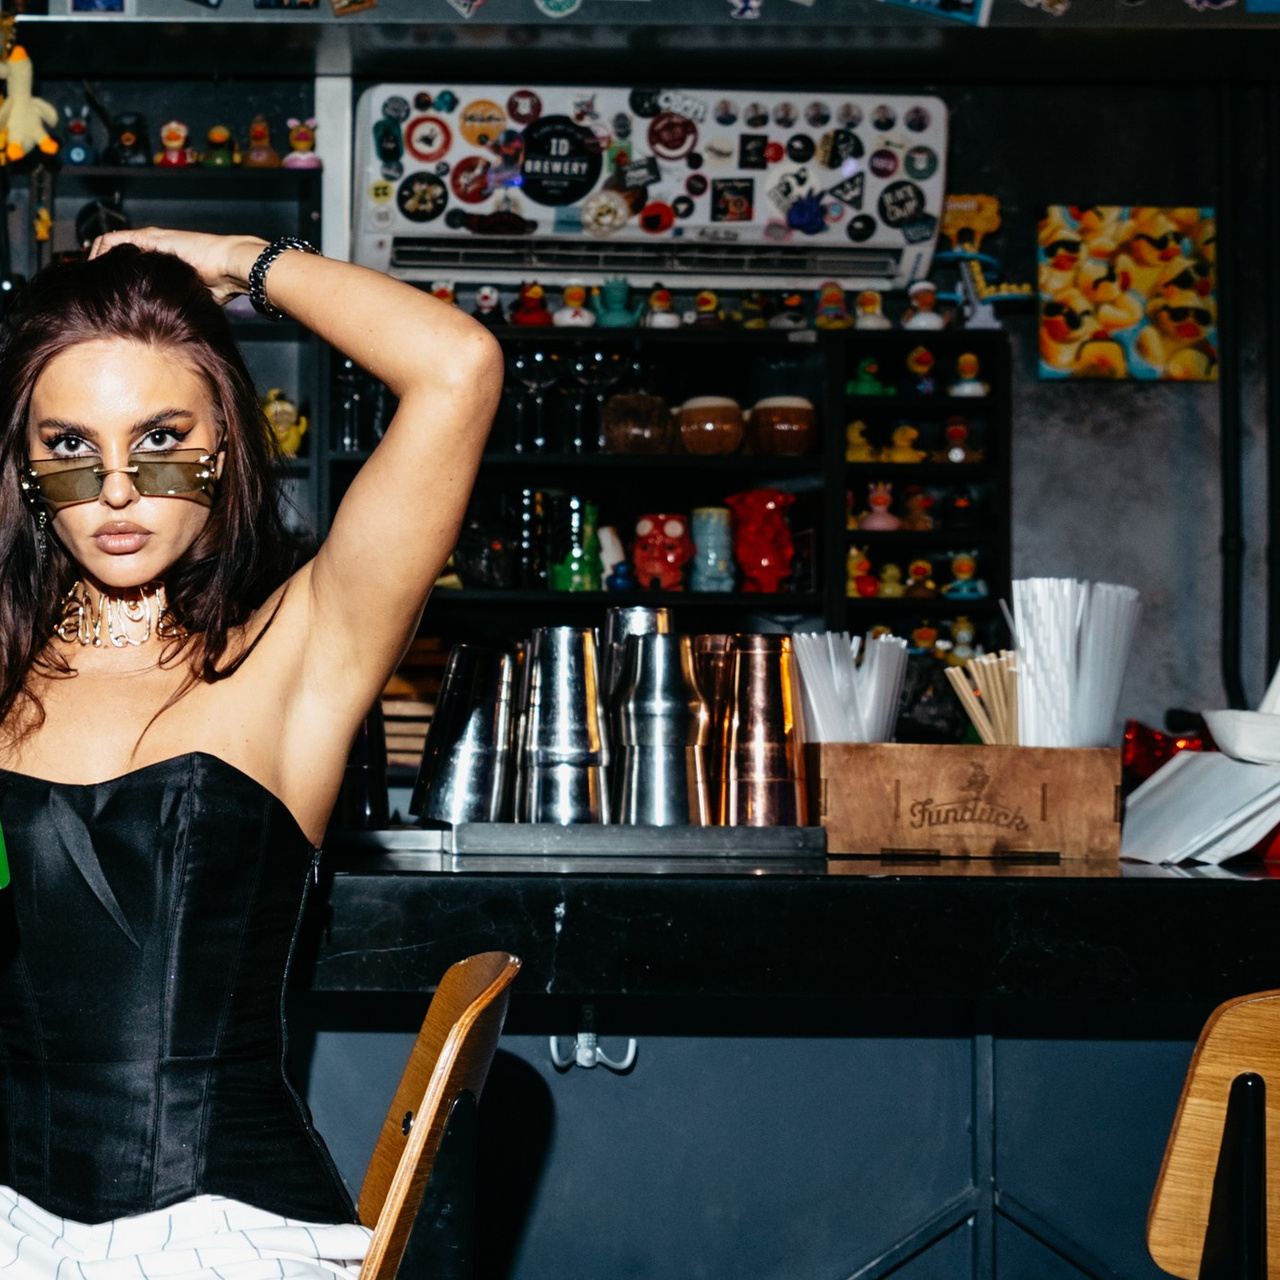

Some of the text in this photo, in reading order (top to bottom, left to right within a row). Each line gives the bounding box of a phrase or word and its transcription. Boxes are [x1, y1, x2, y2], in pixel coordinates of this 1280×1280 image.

[549, 137, 570, 157] ID
[524, 159, 588, 176] BREWERY
[910, 797, 1029, 832] Funduck
